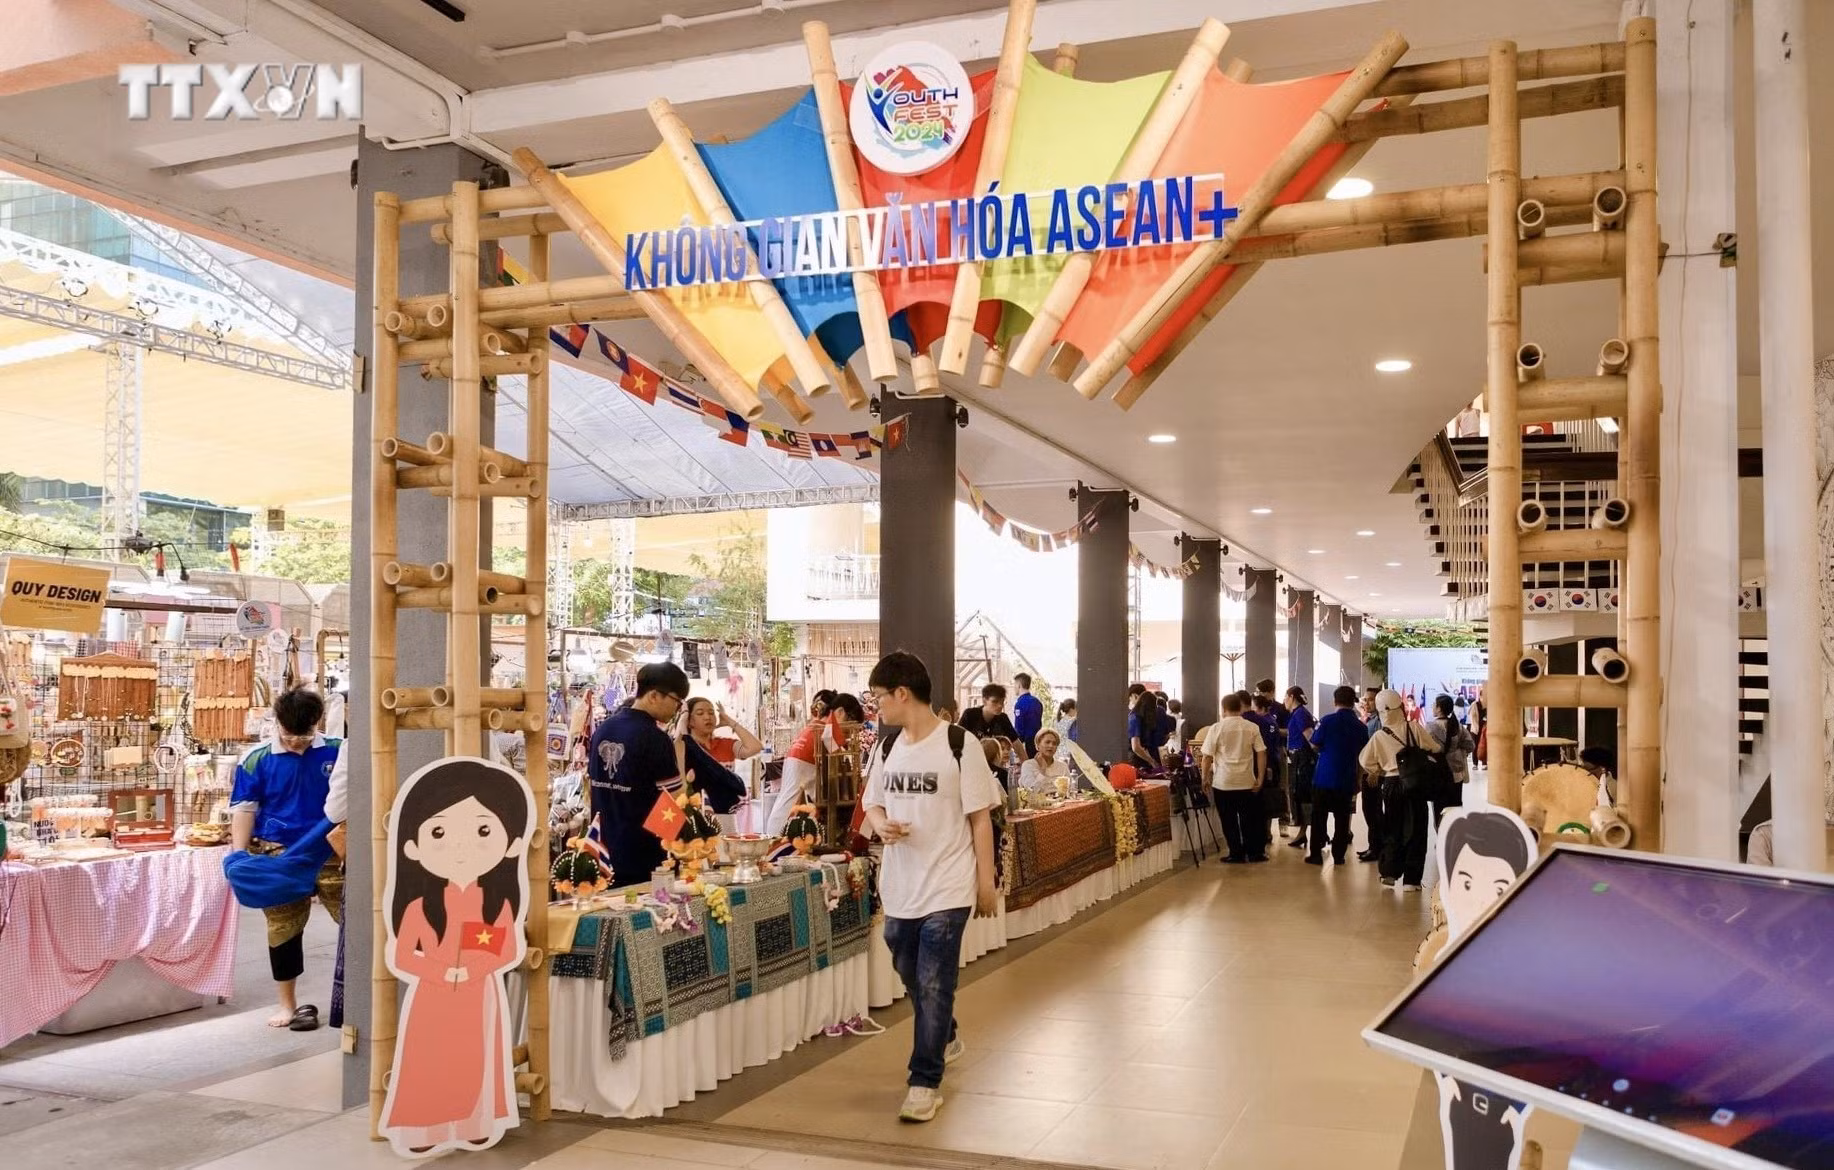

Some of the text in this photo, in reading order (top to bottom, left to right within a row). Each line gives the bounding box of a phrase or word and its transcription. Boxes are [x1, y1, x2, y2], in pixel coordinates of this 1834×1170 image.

[894, 104, 958, 121] FEST
[894, 121, 944, 142] 2024
[625, 176, 1239, 290] KHÔNG GIAN VĂN HÓA ASEAN+
[11, 580, 45, 596] QUY
[47, 585, 102, 604] DESIGN
